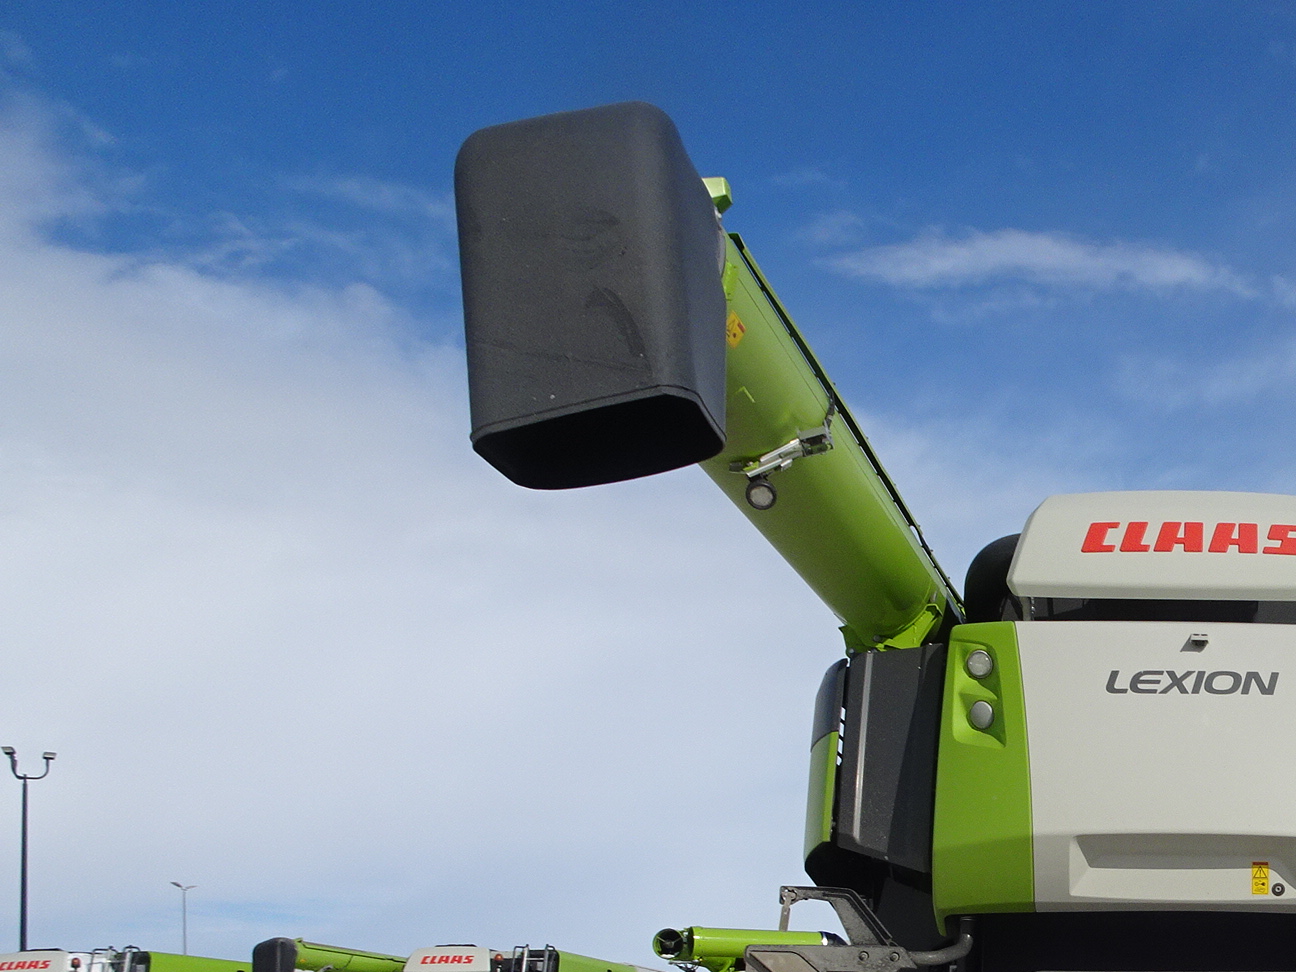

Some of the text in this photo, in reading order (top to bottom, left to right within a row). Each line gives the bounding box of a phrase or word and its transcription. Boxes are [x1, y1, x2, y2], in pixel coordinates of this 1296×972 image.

[1105, 669, 1280, 696] LEXION
[0, 960, 52, 971] CLAAS
[420, 955, 475, 965] CLAAS
